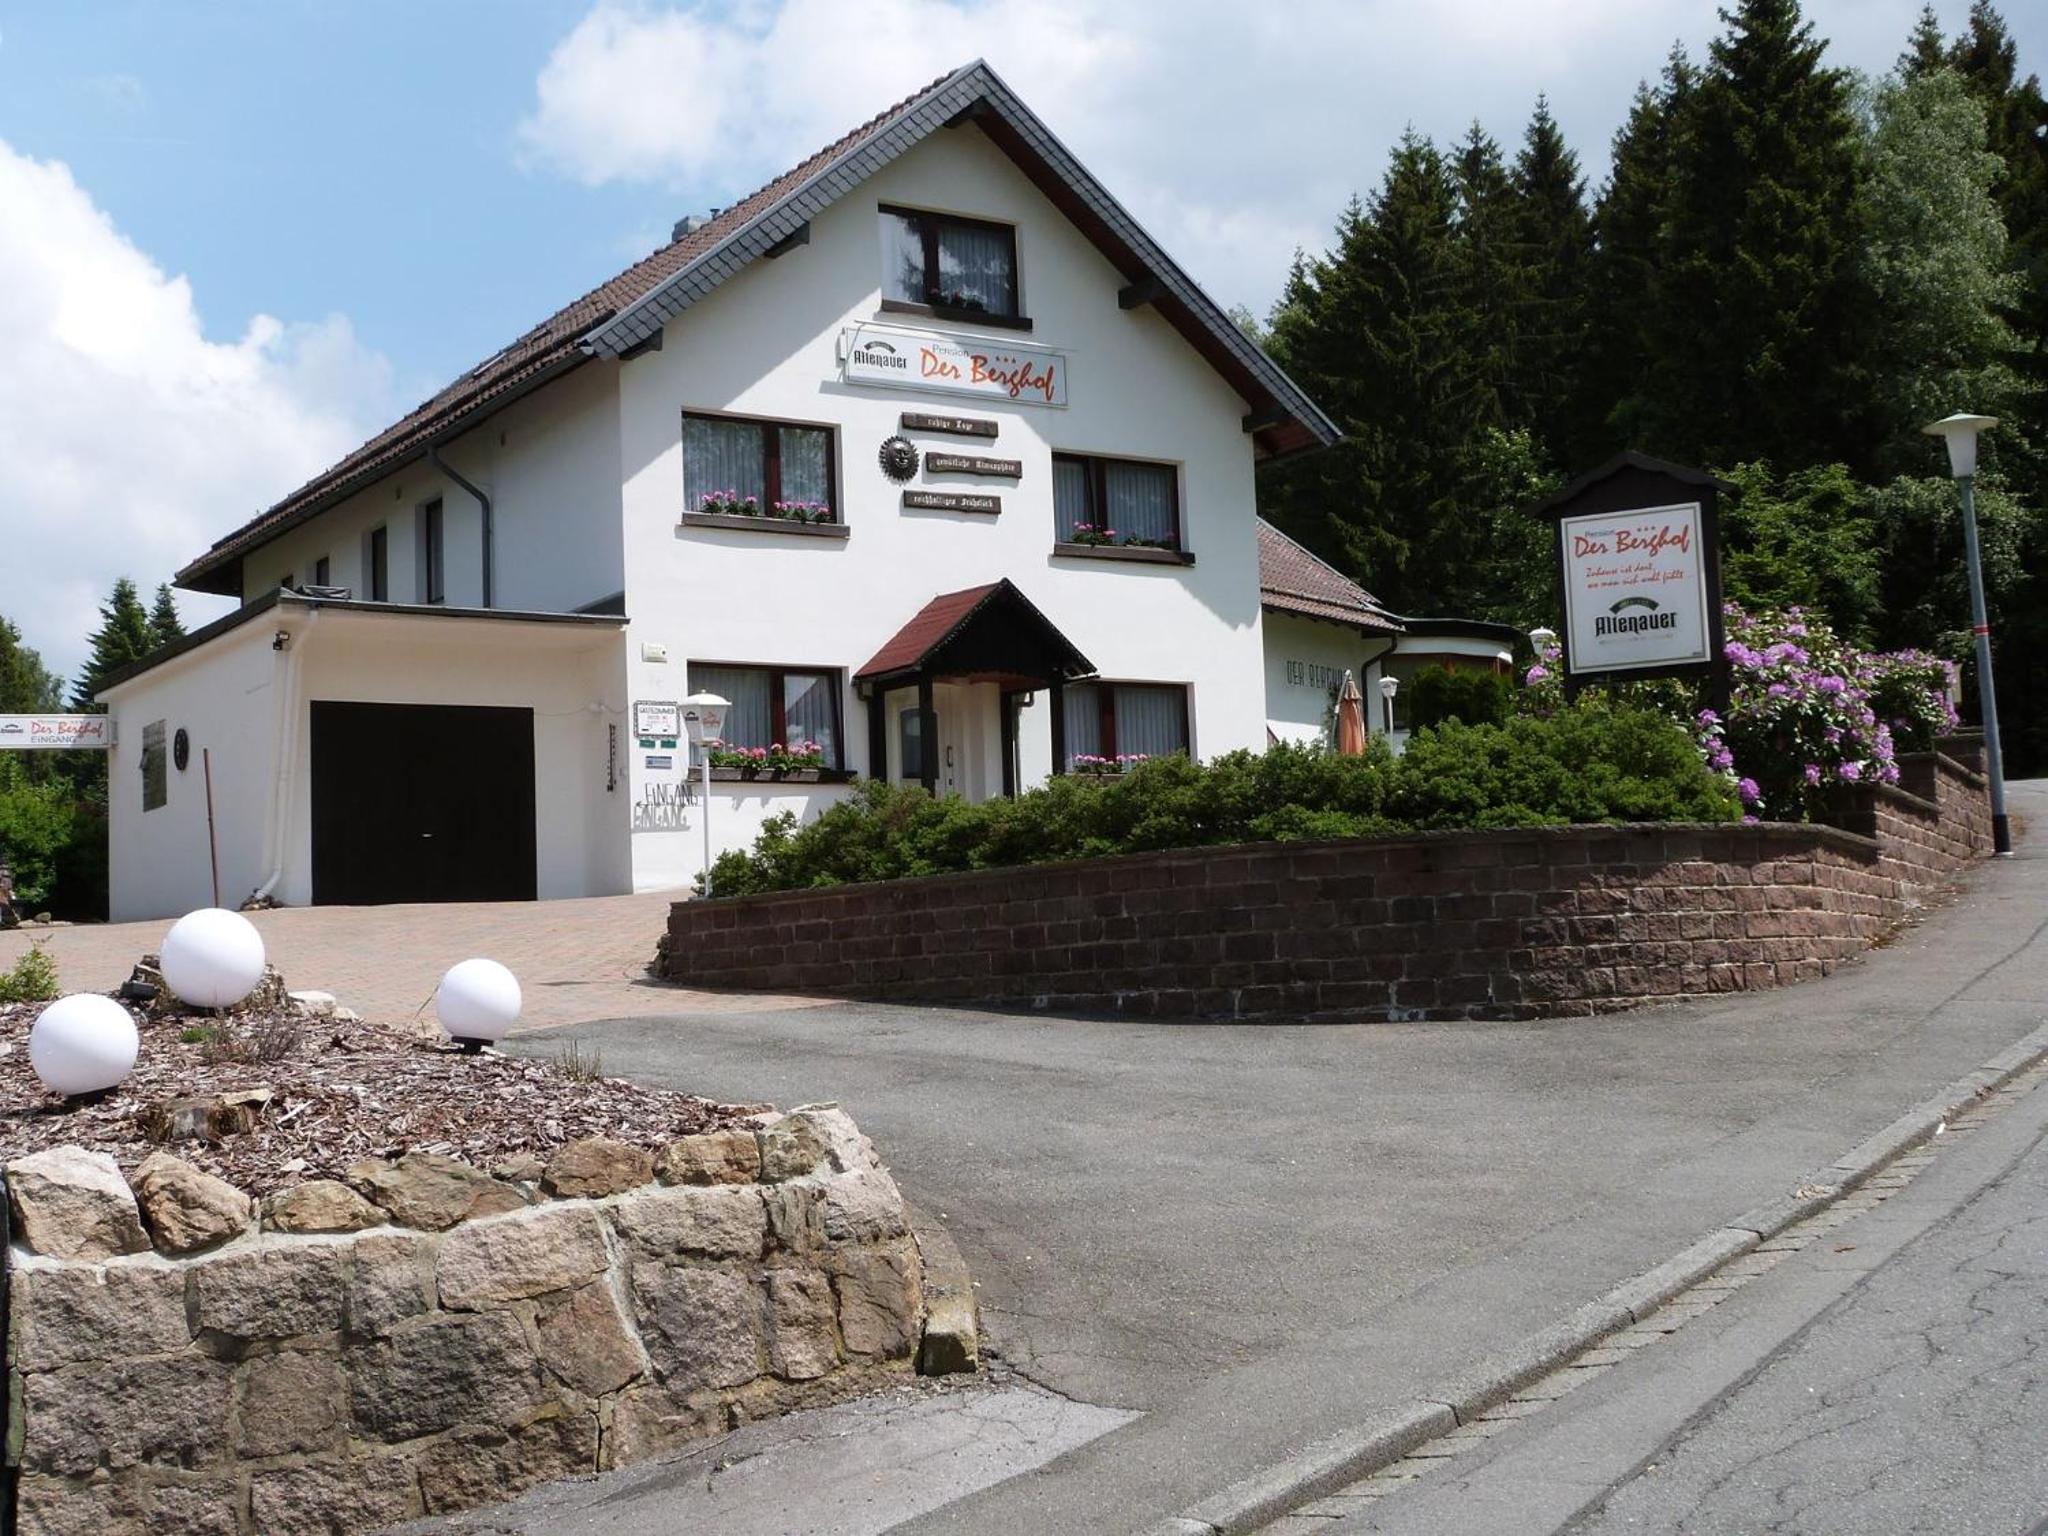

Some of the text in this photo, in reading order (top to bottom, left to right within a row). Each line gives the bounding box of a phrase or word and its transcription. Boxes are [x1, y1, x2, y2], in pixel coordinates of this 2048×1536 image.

[853, 350, 907, 369] Altenauer
[920, 347, 1054, 401] Der Berghof
[1574, 524, 1690, 559] Der Berghof
[1595, 612, 1677, 637] Altenauer
[1287, 661, 1304, 685] DER
[31, 721, 103, 739] Der Berghof
